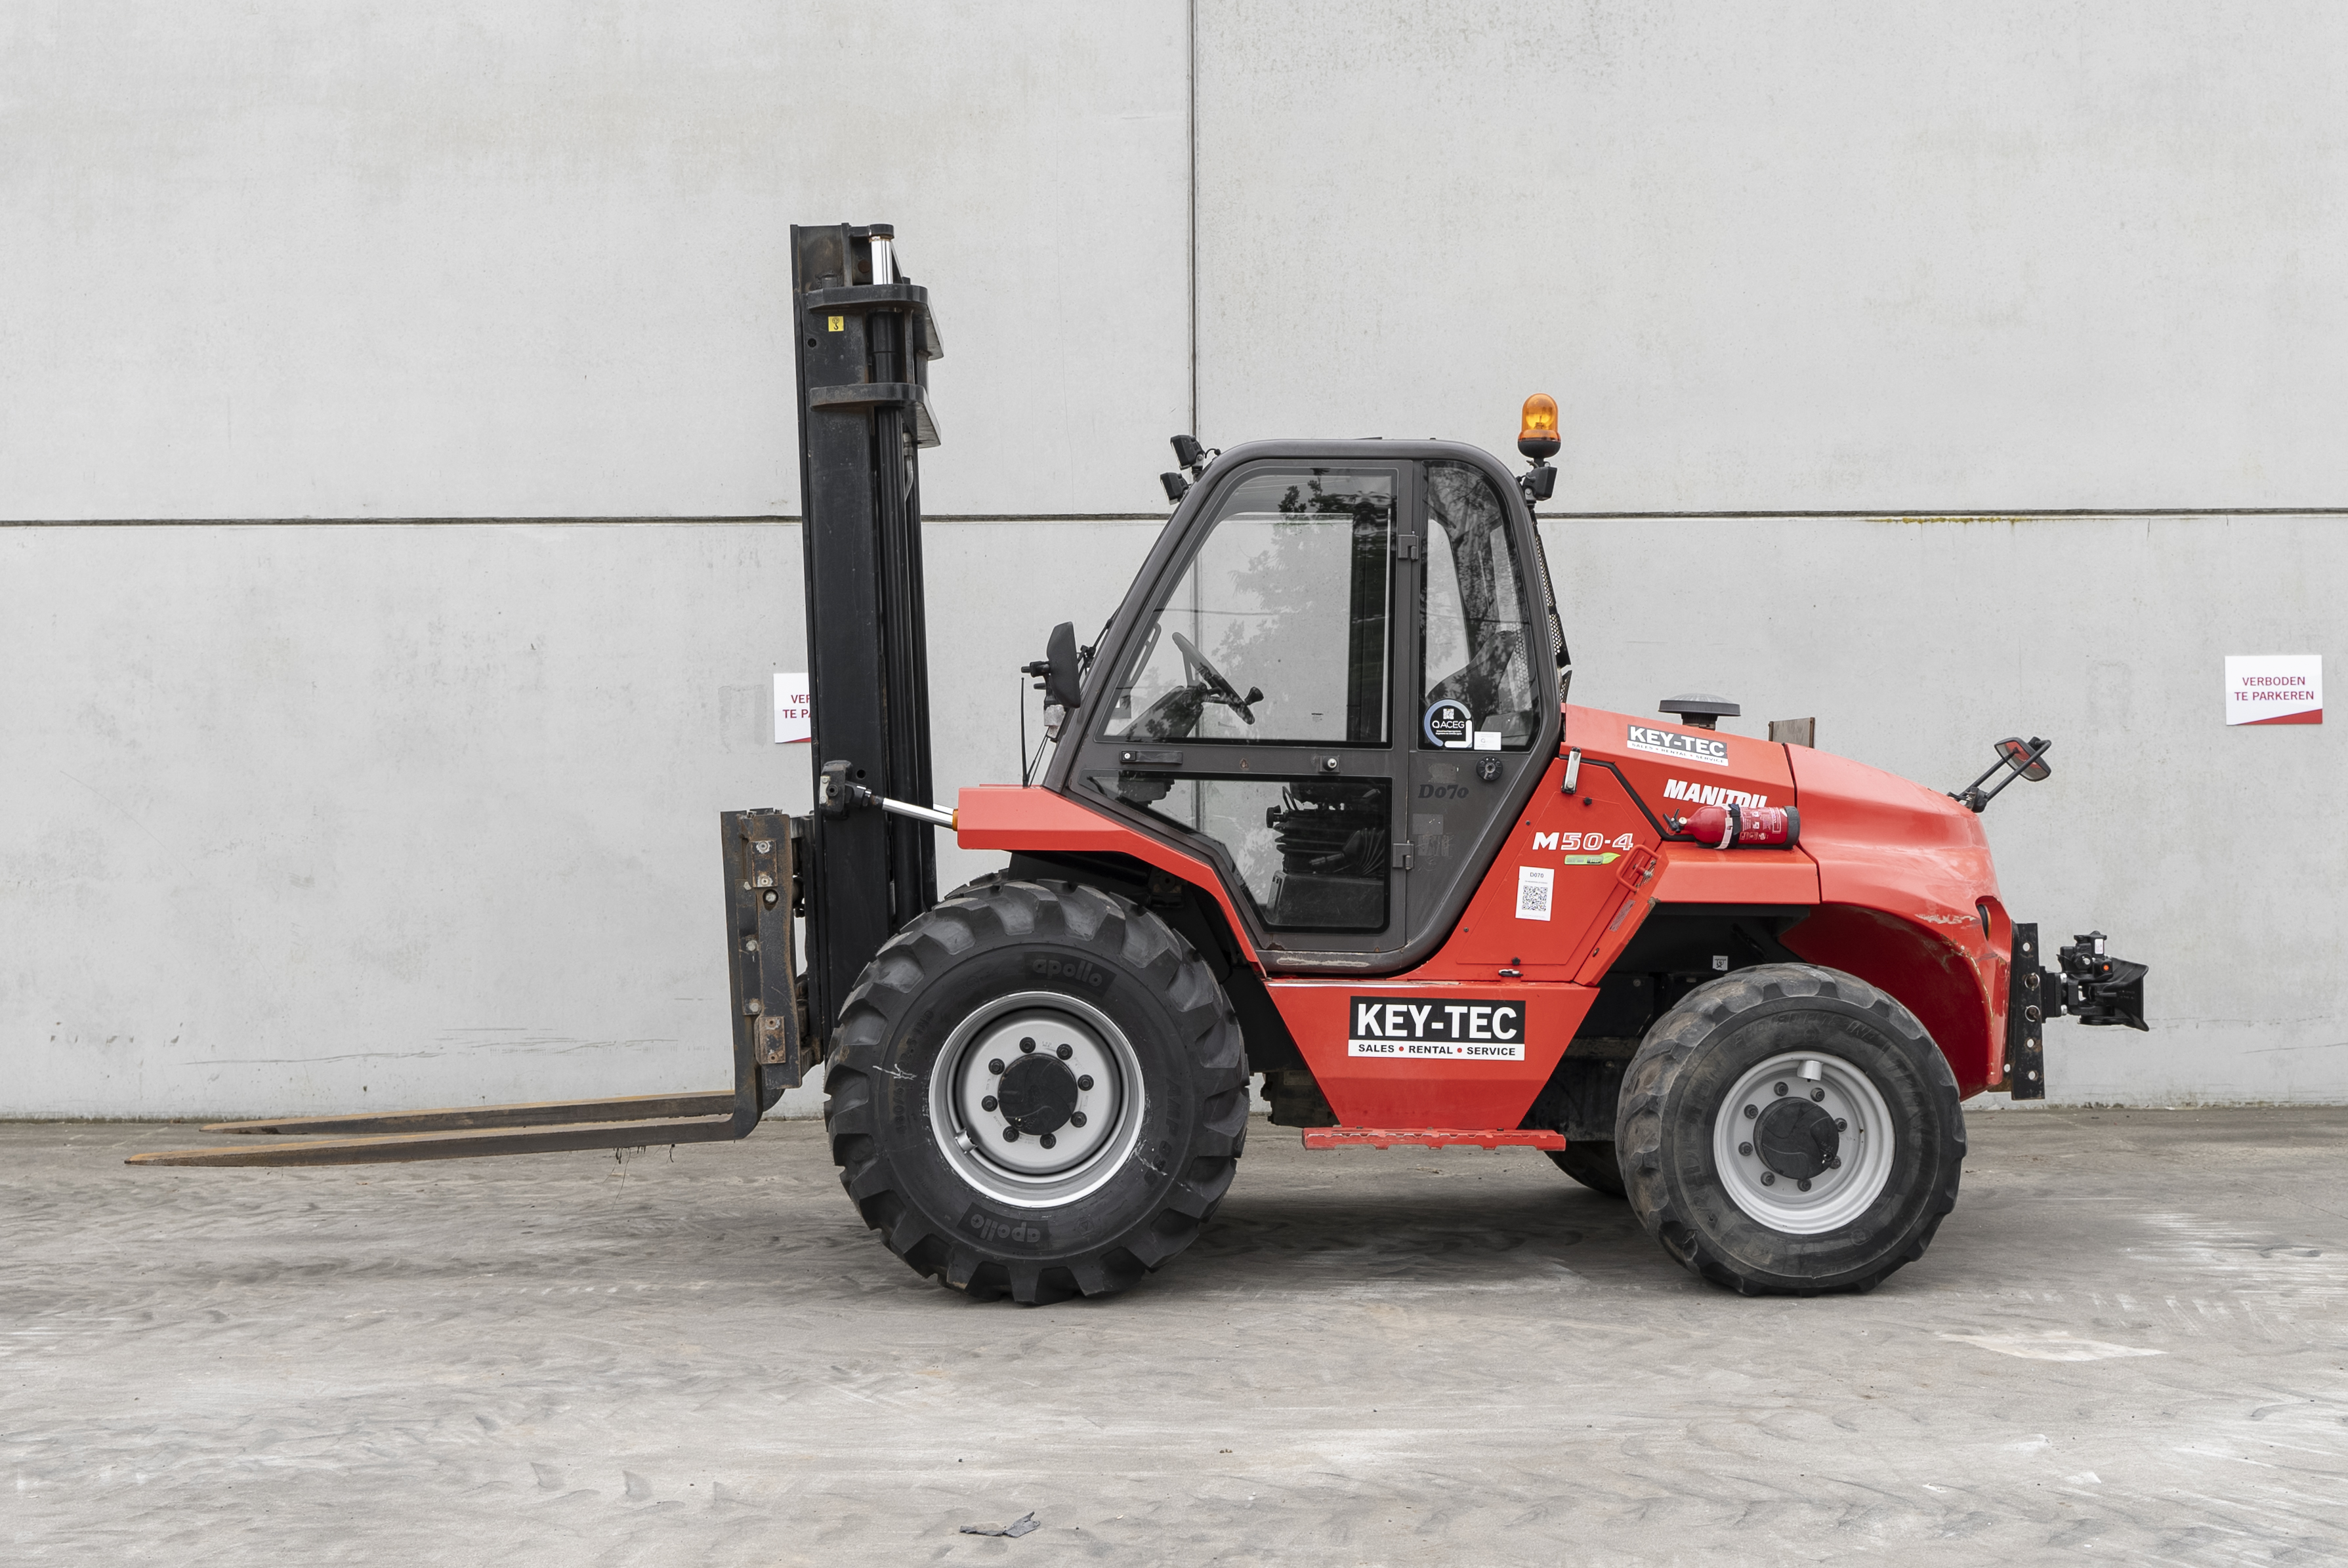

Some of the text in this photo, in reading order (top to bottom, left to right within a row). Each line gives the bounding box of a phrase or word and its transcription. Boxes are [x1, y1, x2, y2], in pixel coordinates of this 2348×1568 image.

[2242, 676, 2306, 686] VERBODEN
[2234, 690, 2314, 701] TE PARKEREN
[782, 709, 811, 718] TE P
[1630, 726, 1725, 757] KEY-TEC
[1661, 749, 1688, 757] RENTAL
[1696, 755, 1725, 764] SERVICE
[1032, 959, 1102, 987] apollo
[1357, 1003, 1517, 1040] KEY-TEC
[1358, 1044, 1515, 1056] SALES RENTAL SERVICE
[970, 1213, 1041, 1243] apollo
